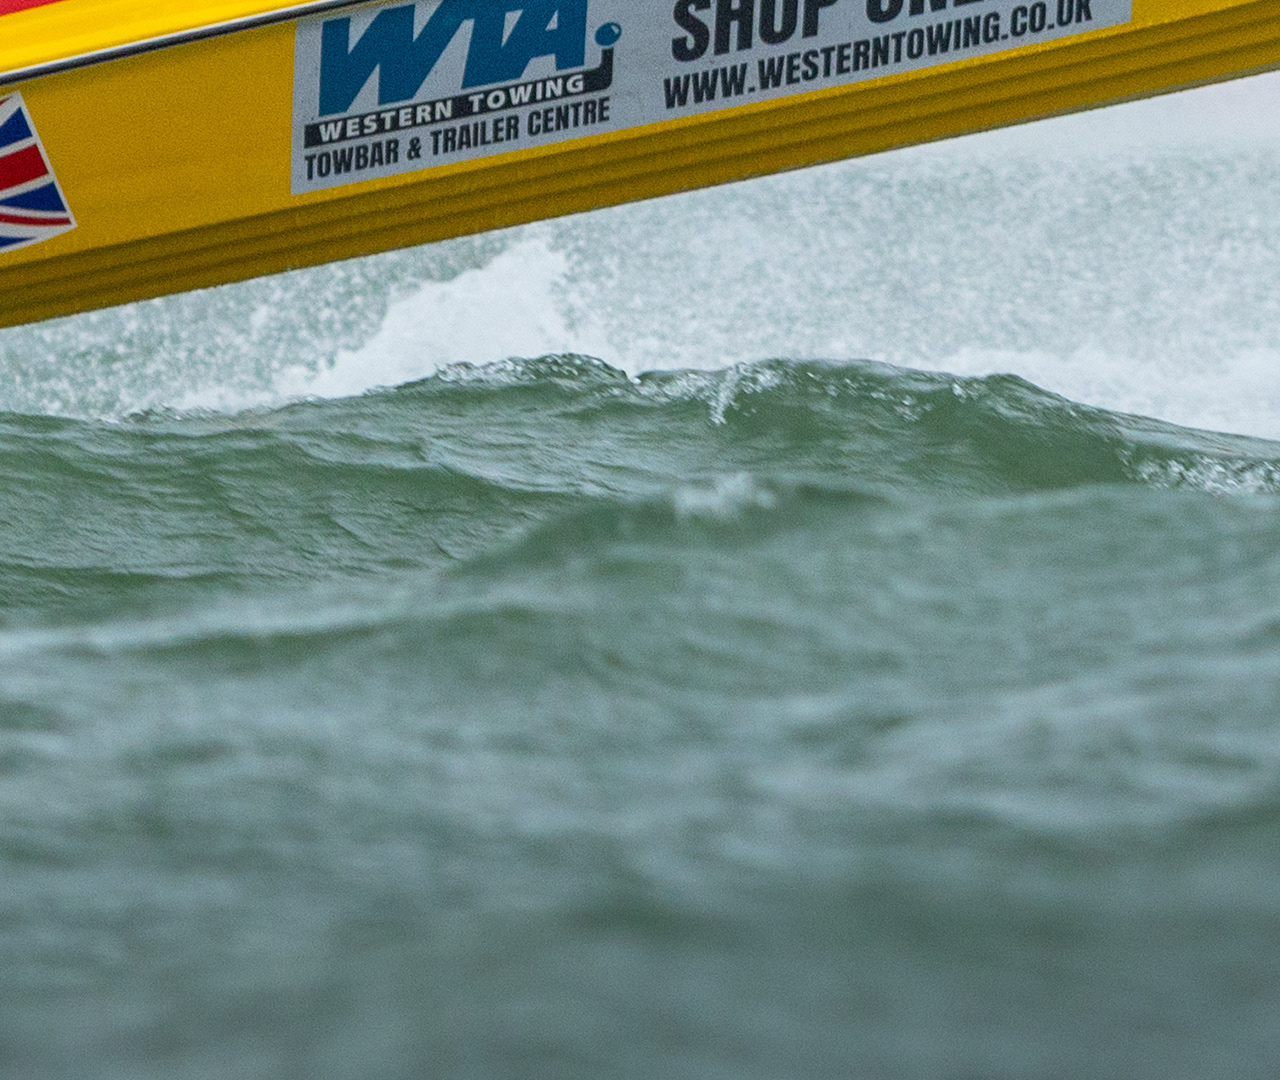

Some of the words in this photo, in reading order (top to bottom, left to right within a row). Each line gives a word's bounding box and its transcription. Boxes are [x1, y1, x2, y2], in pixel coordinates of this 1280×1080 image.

[304, 138, 399, 181] TOWBAR
[406, 133, 422, 160] &
[430, 111, 520, 156] TRAILER
[527, 96, 611, 138] CENTRE
[319, 100, 454, 144] WESTERN
[468, 73, 586, 110] TOWING
